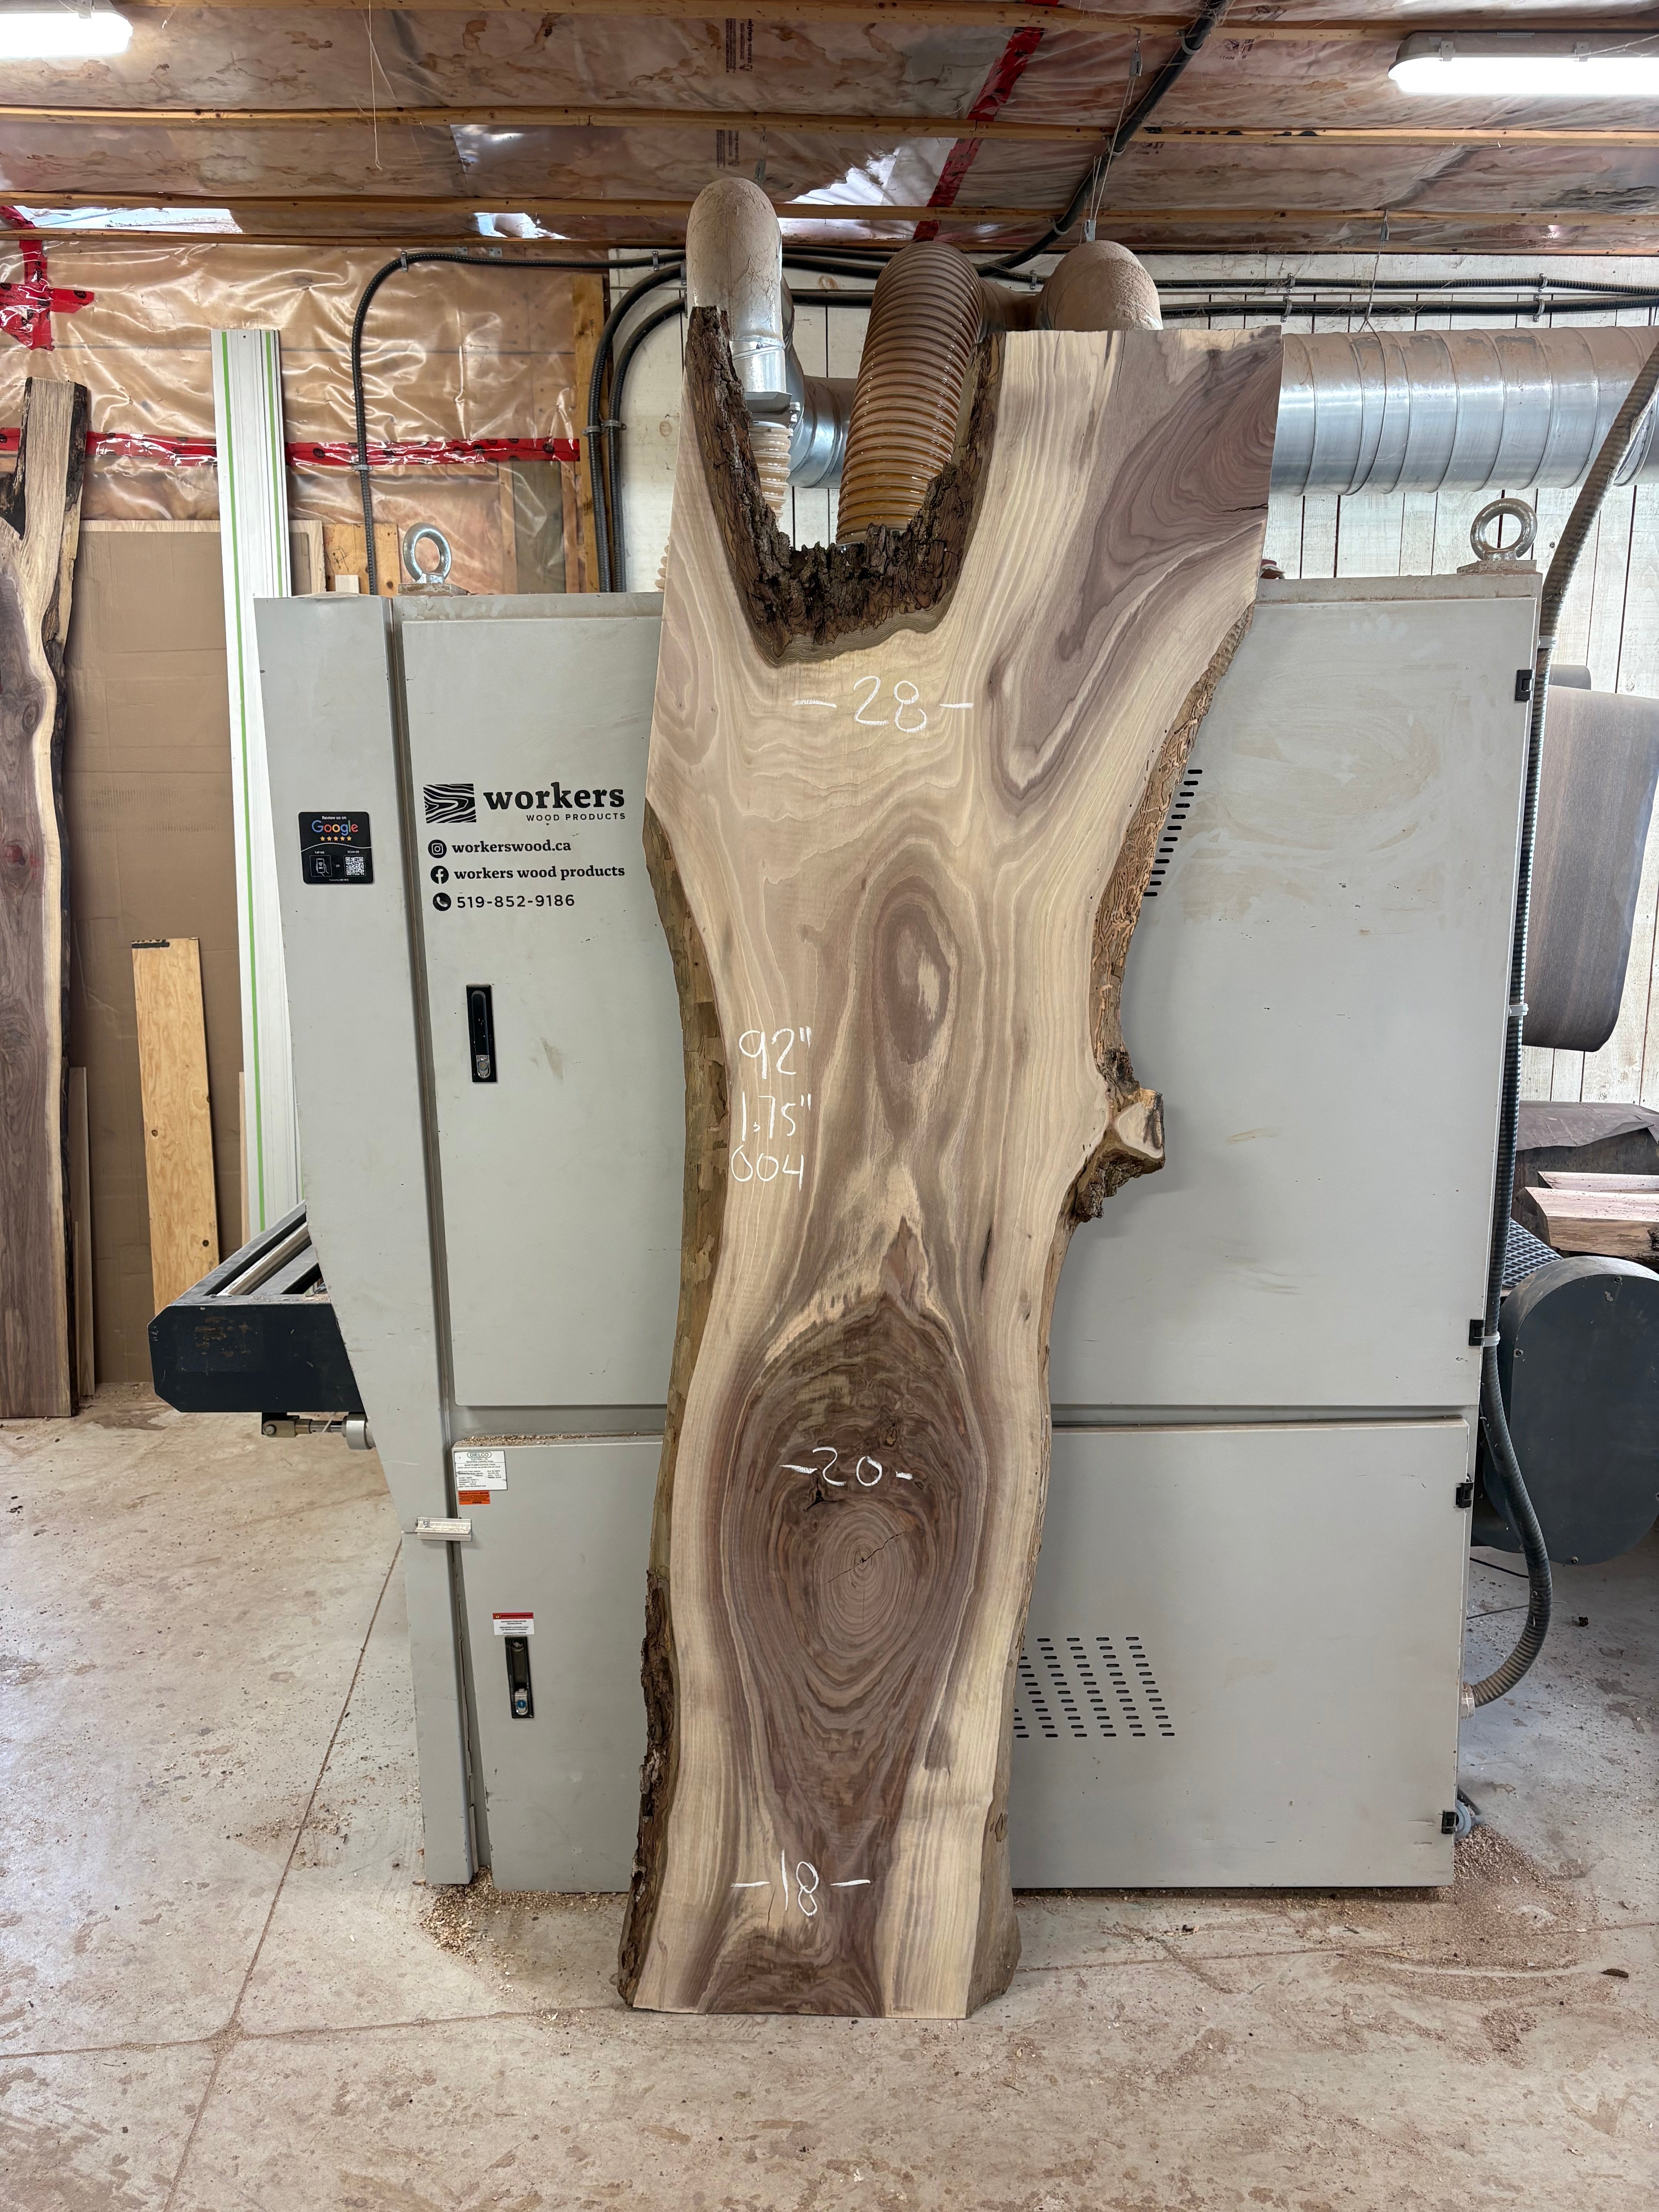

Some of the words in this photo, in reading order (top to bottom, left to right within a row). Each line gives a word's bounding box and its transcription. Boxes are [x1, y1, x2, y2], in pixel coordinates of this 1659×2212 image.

[483, 781, 625, 810] workers
[311, 820, 359, 836] Google
[452, 839, 572, 853] workerswood.ca
[454, 867, 514, 879] workers
[517, 866, 557, 878] wood
[560, 865, 625, 881] products
[457, 894, 575, 908] 519-852-9186
[739, 1025, 812, 1079] 92"
